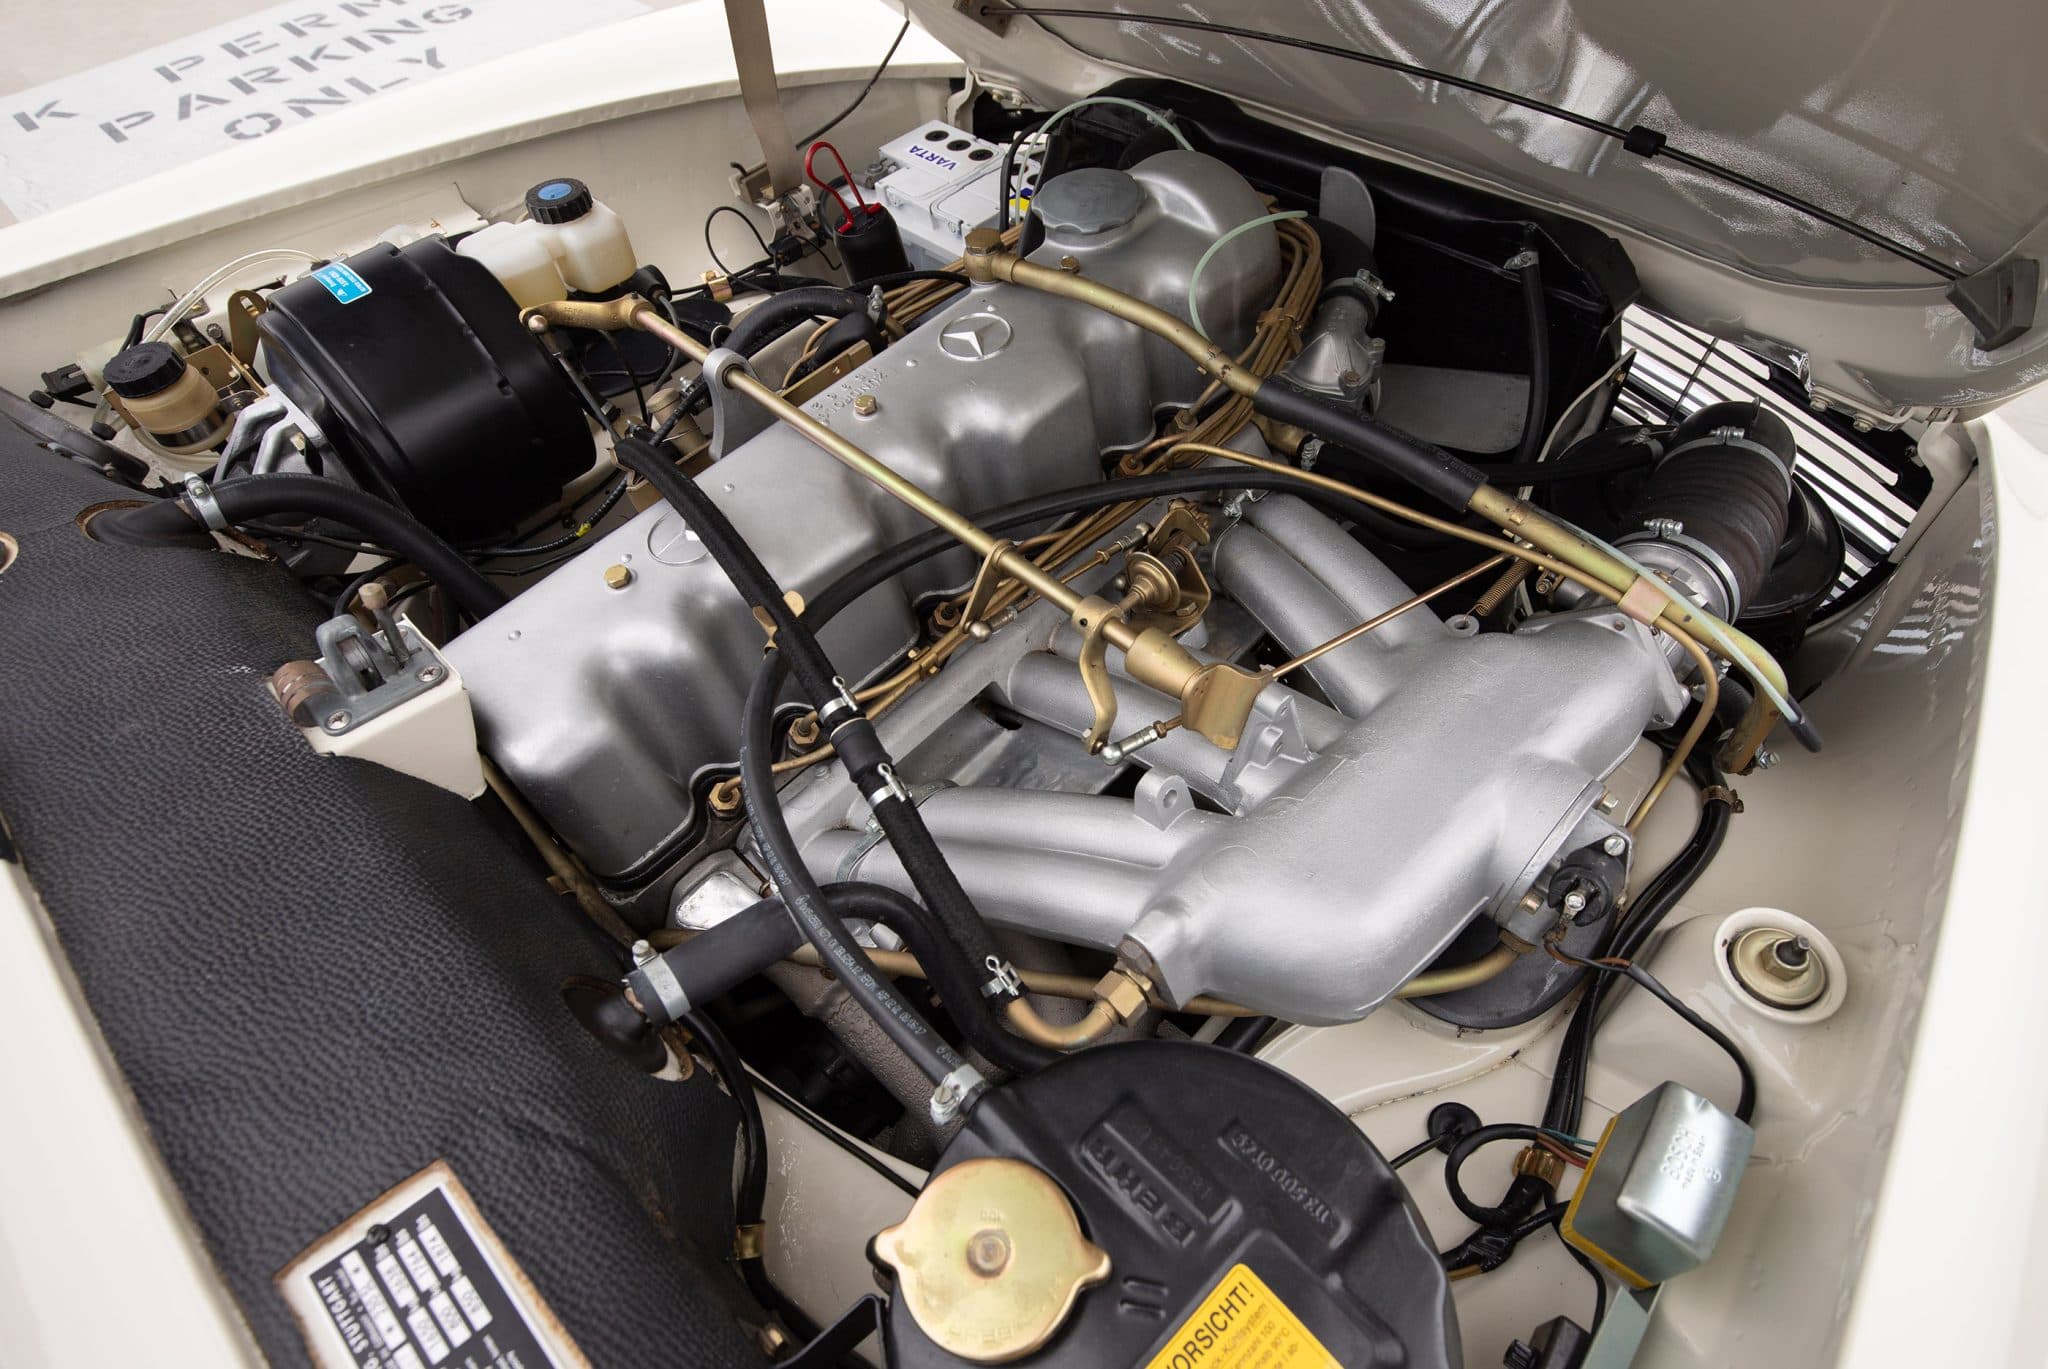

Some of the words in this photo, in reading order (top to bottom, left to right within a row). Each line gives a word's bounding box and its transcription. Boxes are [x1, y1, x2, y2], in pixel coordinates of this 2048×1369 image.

[12, 99, 80, 132] K
[98, 3, 473, 144] PARKING
[223, 46, 446, 141] ONLY
[909, 145, 957, 170] VARTA
[317, 1275, 370, 1355] STUTTGART
[1167, 1281, 1255, 1369] ORSICHT!
